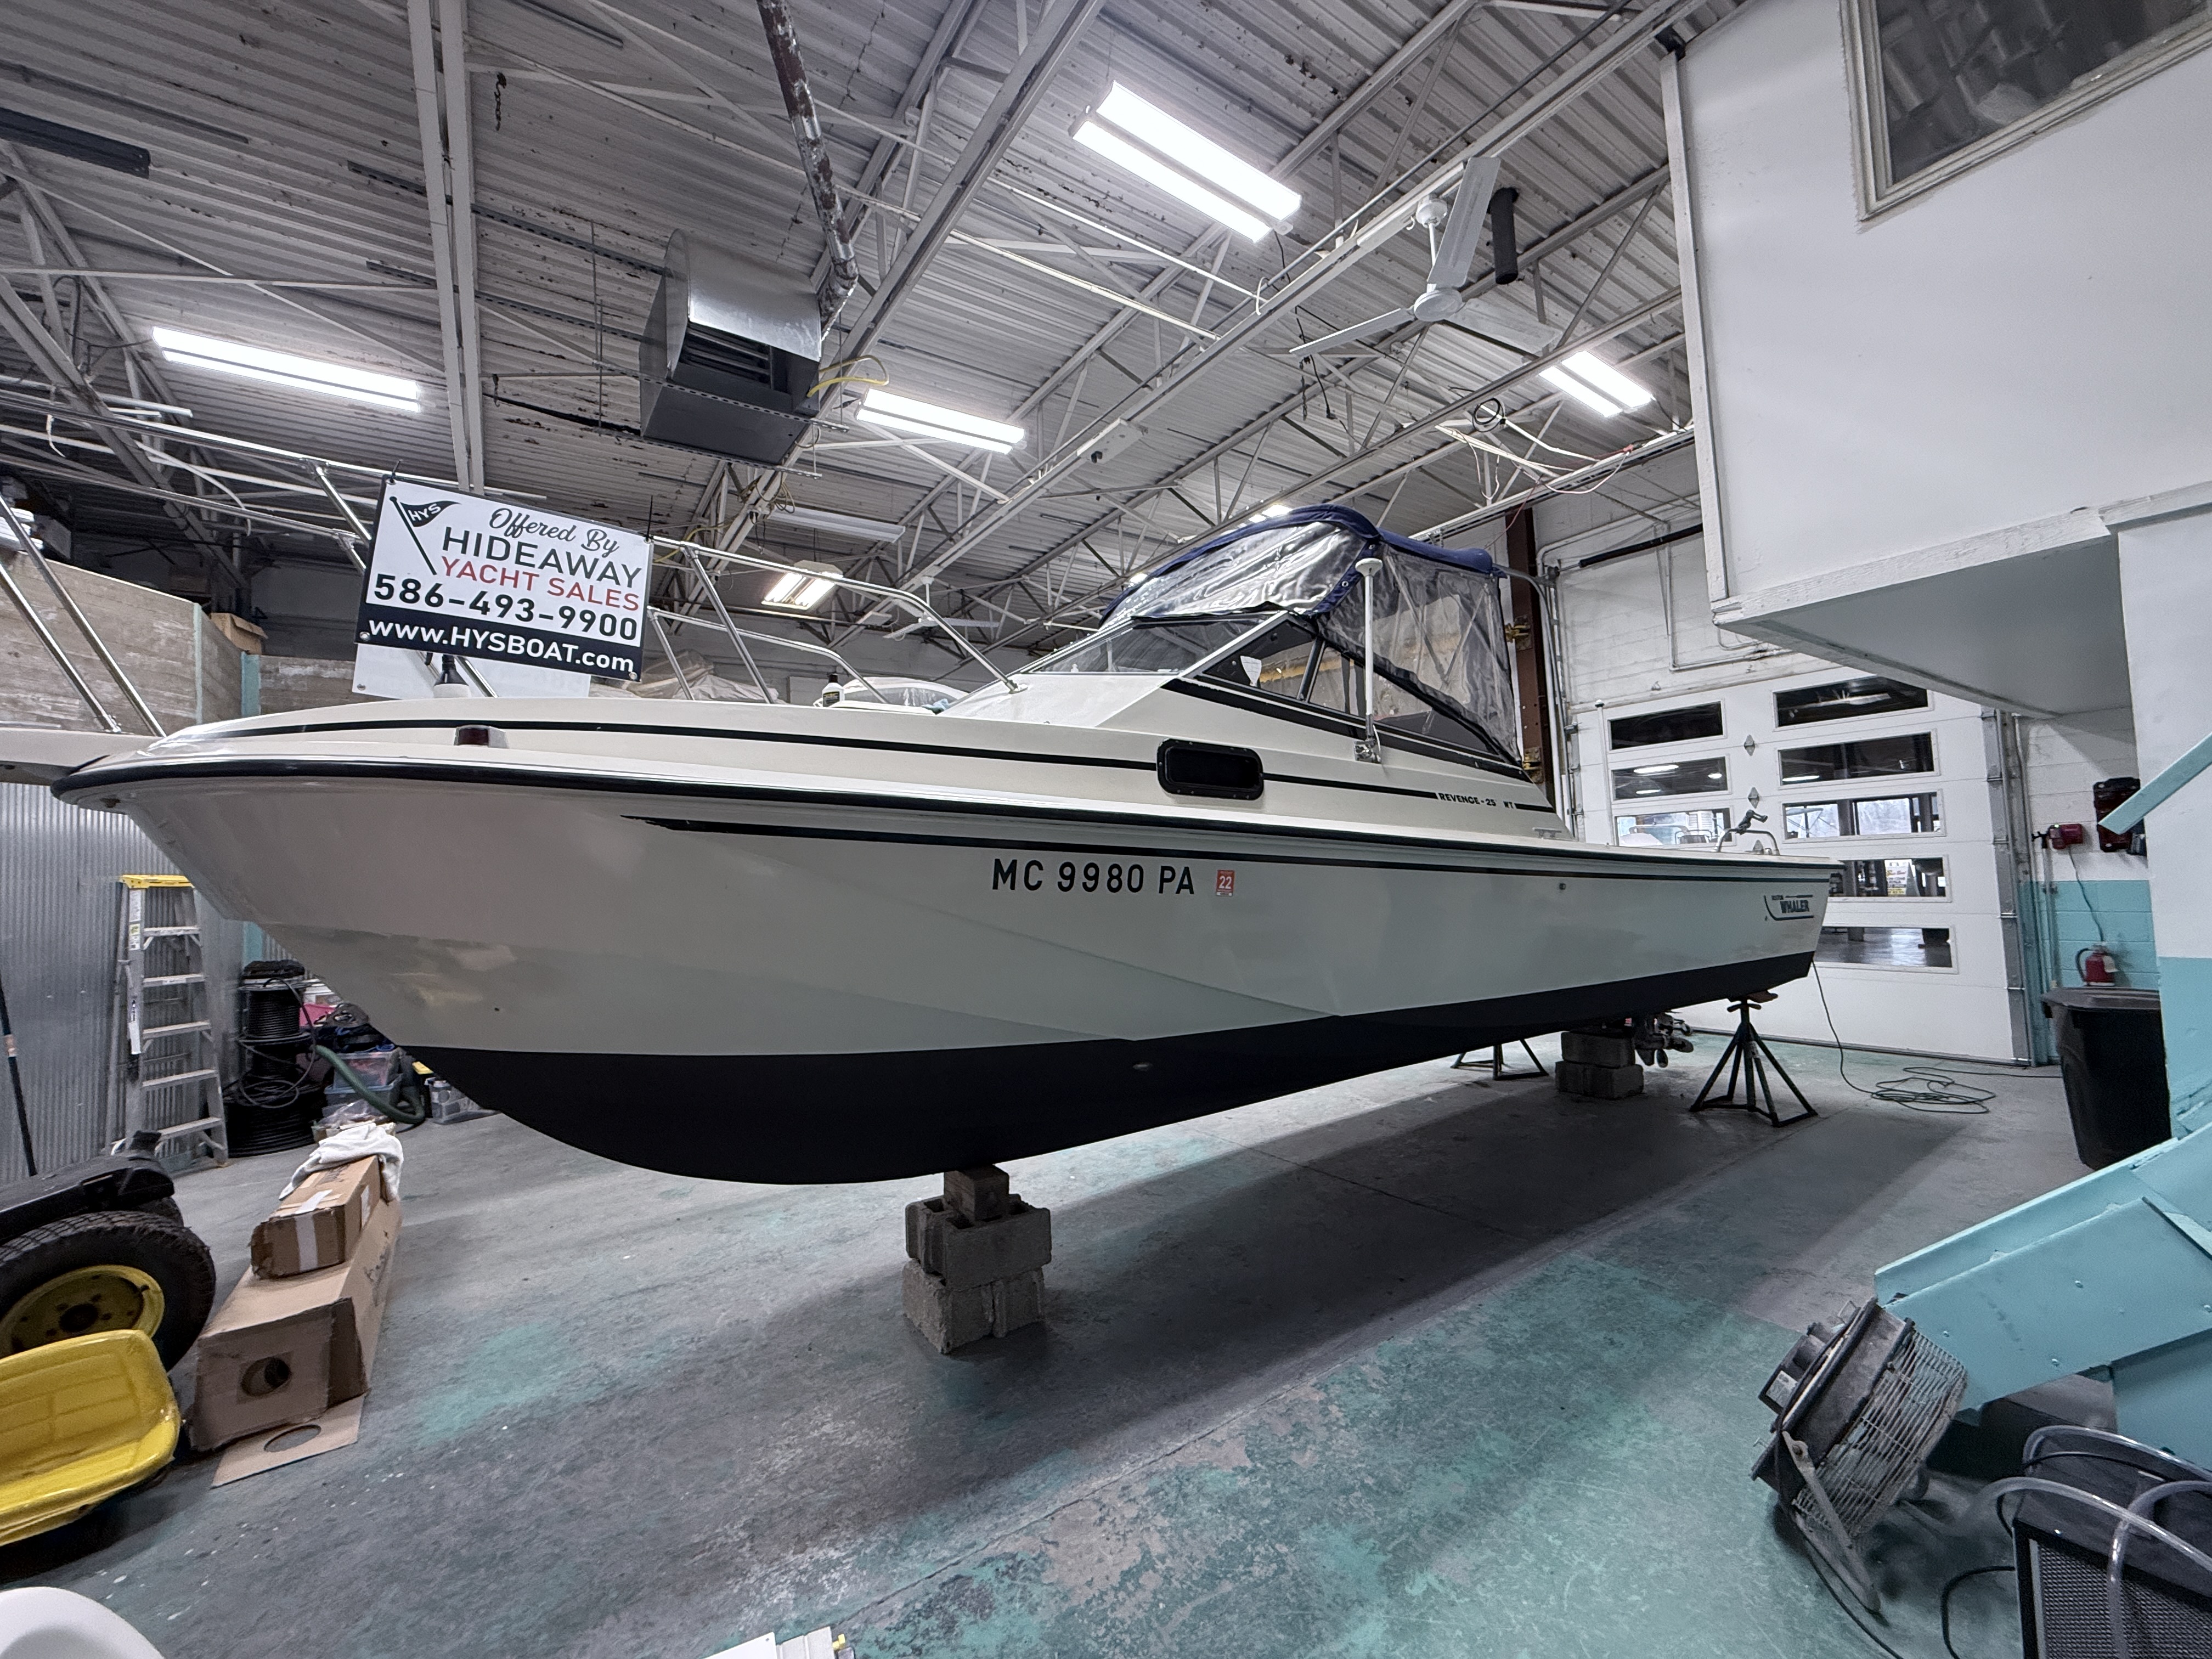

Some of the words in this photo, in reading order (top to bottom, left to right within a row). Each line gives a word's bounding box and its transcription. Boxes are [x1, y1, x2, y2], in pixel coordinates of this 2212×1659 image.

[408, 503, 441, 521] HYS
[489, 508, 576, 541] Offered
[582, 529, 620, 558] By
[442, 527, 641, 588] HIDEAWAY
[374, 573, 637, 641] 586-493-9900
[441, 556, 540, 591] YACHT
[547, 578, 639, 611] SALES
[369, 620, 634, 673] www.HYSBOAT.com
[992, 859, 1043, 891] MC
[1057, 861, 1144, 893] 9980
[1158, 866, 1194, 895] PA
[1219, 876, 1232, 889] 22
